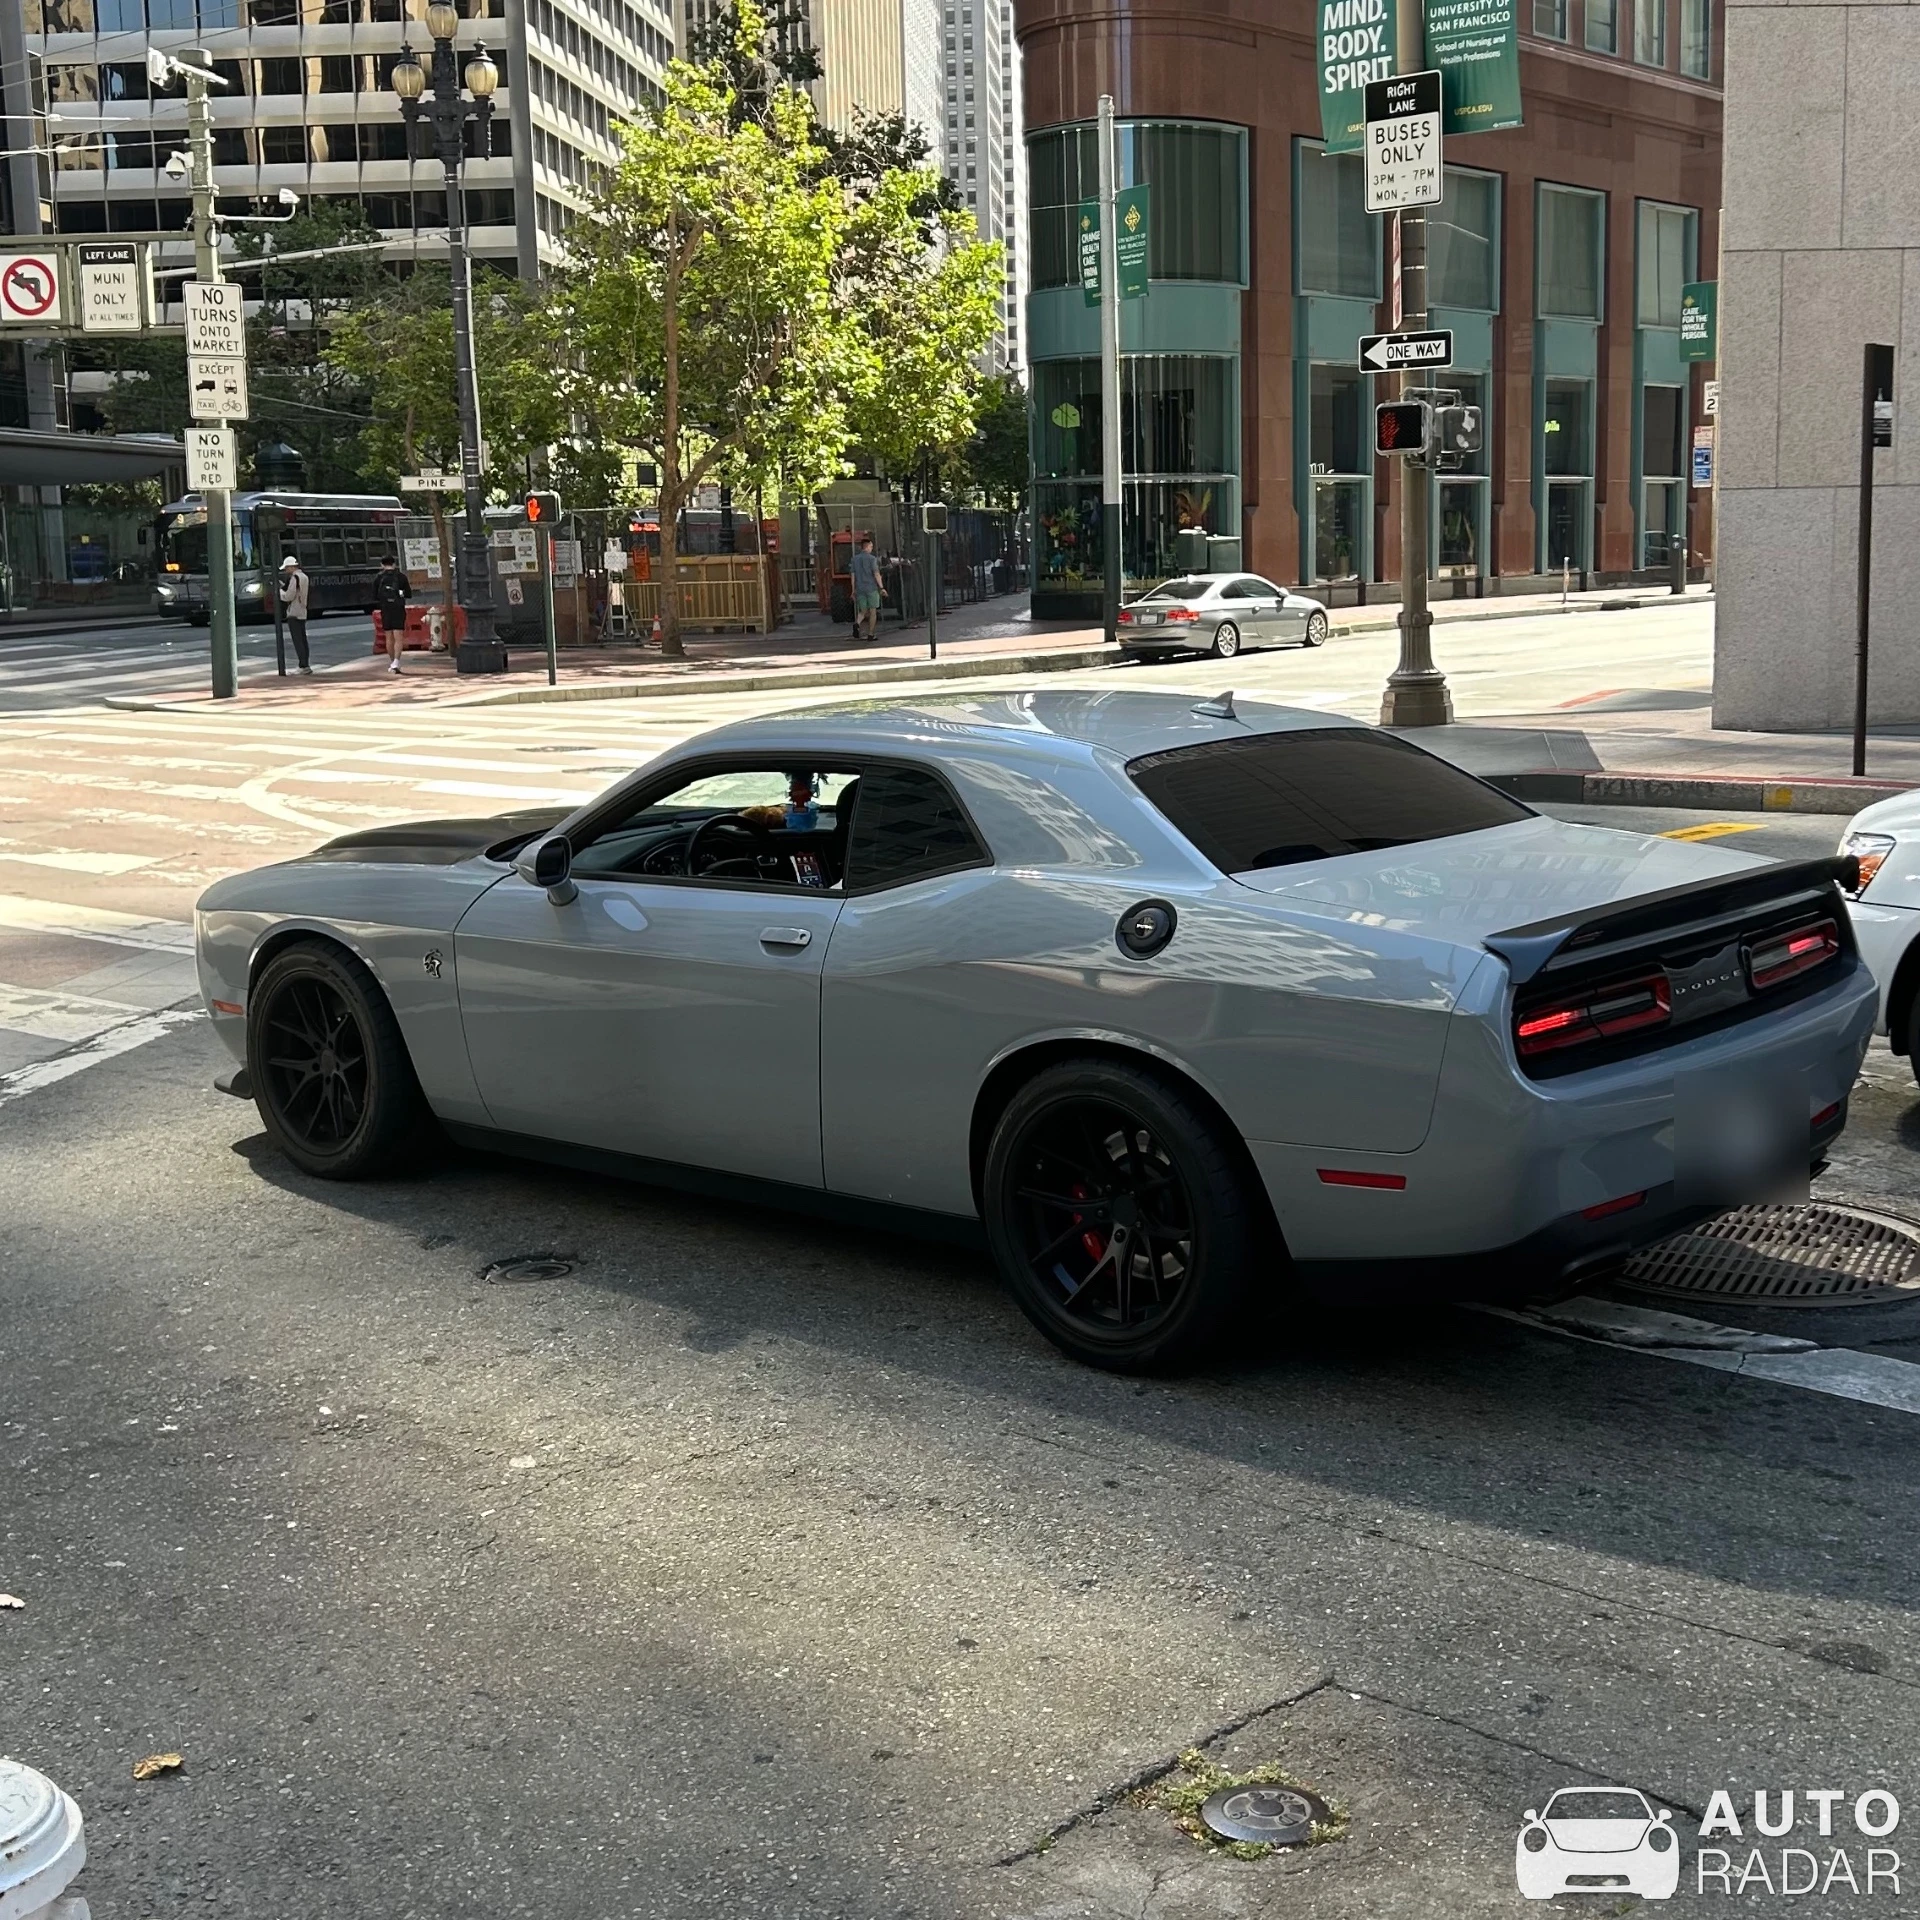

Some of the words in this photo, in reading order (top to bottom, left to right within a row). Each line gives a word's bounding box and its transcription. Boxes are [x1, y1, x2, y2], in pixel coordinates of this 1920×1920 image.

[1323, 0, 1388, 31] MIND.
[1430, 0, 1493, 18] UNIVERSITY
[1430, 20, 1450, 33] SAN
[1453, 10, 1511, 28] FRANCISCO
[1323, 25, 1387, 63] BODY.
[1435, 40, 1457, 53] School
[1458, 40, 1465, 49] of
[1466, 36, 1492, 48] Nursing
[1492, 34, 1506, 44] and
[1440, 55, 1462, 65] Health
[1463, 50, 1501, 61] Professions
[1387, 82, 1417, 99] RIGHT
[1388, 99, 1416, 114] LANE
[1375, 120, 1431, 145] BUSES
[1381, 143, 1425, 165] ONLY
[1373, 173, 1395, 186] 3PM
[1412, 167, 1435, 180] 7PM
[1376, 189, 1398, 201] MON
[1415, 185, 1432, 196] FRI
[86, 251, 105, 260] LEFT
[107, 250, 129, 260] LANE
[93, 272, 125, 285] MUNI
[93, 293, 127, 305] ONLY
[202, 288, 224, 305] NO
[89, 313, 99, 322] AT
[100, 313, 112, 321] ALL
[112, 312, 135, 321] TIMES
[190, 308, 237, 323] TURNS
[1682, 307, 1700, 315] CARE
[1681, 323, 1706, 331] WHOLE
[1682, 316, 1695, 324] FOR
[199, 326, 231, 338] ONTO
[192, 340, 240, 352] MARKET
[1387, 345, 1411, 359] ONE
[1416, 342, 1442, 357] WAY
[198, 364, 235, 375] EXCEPT
[198, 434, 220, 446] NO
[197, 449, 225, 459] TURN
[203, 462, 219, 471] ON
[201, 474, 222, 484] RED
[418, 478, 446, 488] PINE
[1675, 969, 1742, 995] DODGE
